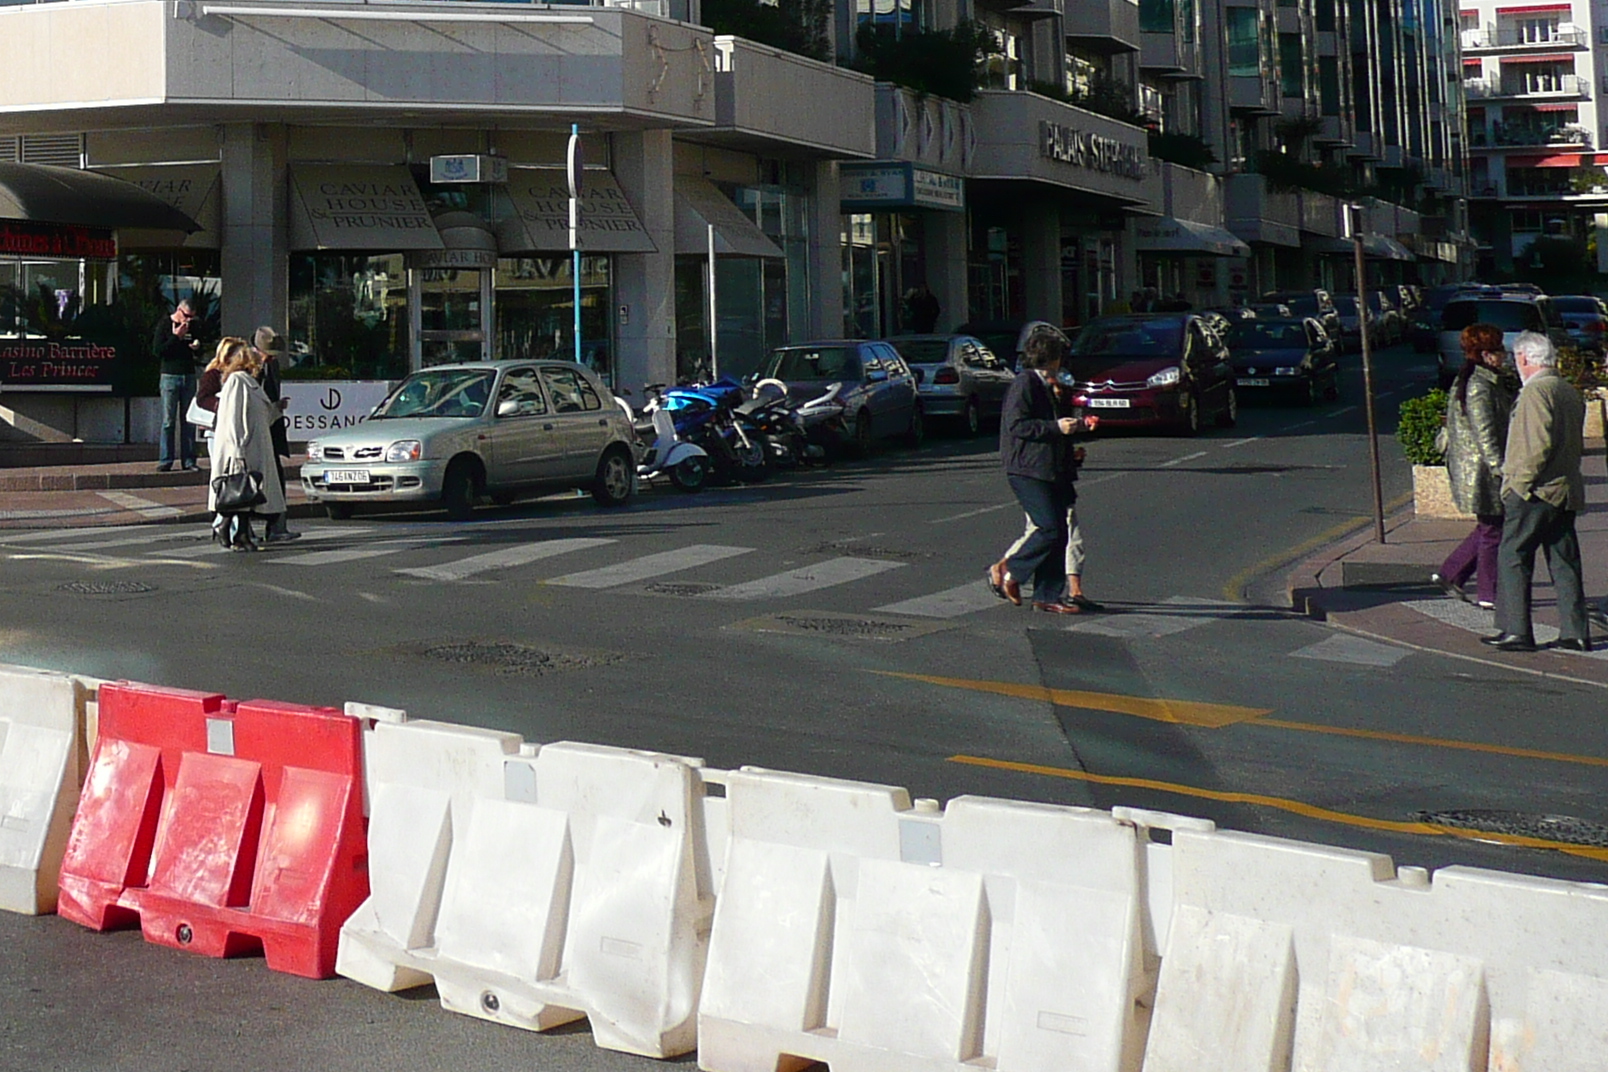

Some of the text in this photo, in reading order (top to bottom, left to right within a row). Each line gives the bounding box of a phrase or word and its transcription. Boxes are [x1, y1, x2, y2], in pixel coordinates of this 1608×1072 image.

[320, 181, 417, 197] CAVIAR
[528, 186, 623, 199] CAVAR
[326, 197, 426, 212] HOUSE
[333, 214, 432, 229] PRUNIER
[428, 251, 469, 263] AVIAR
[47, 341, 116, 359] Barrière
[8, 361, 100, 378] Les Princes
